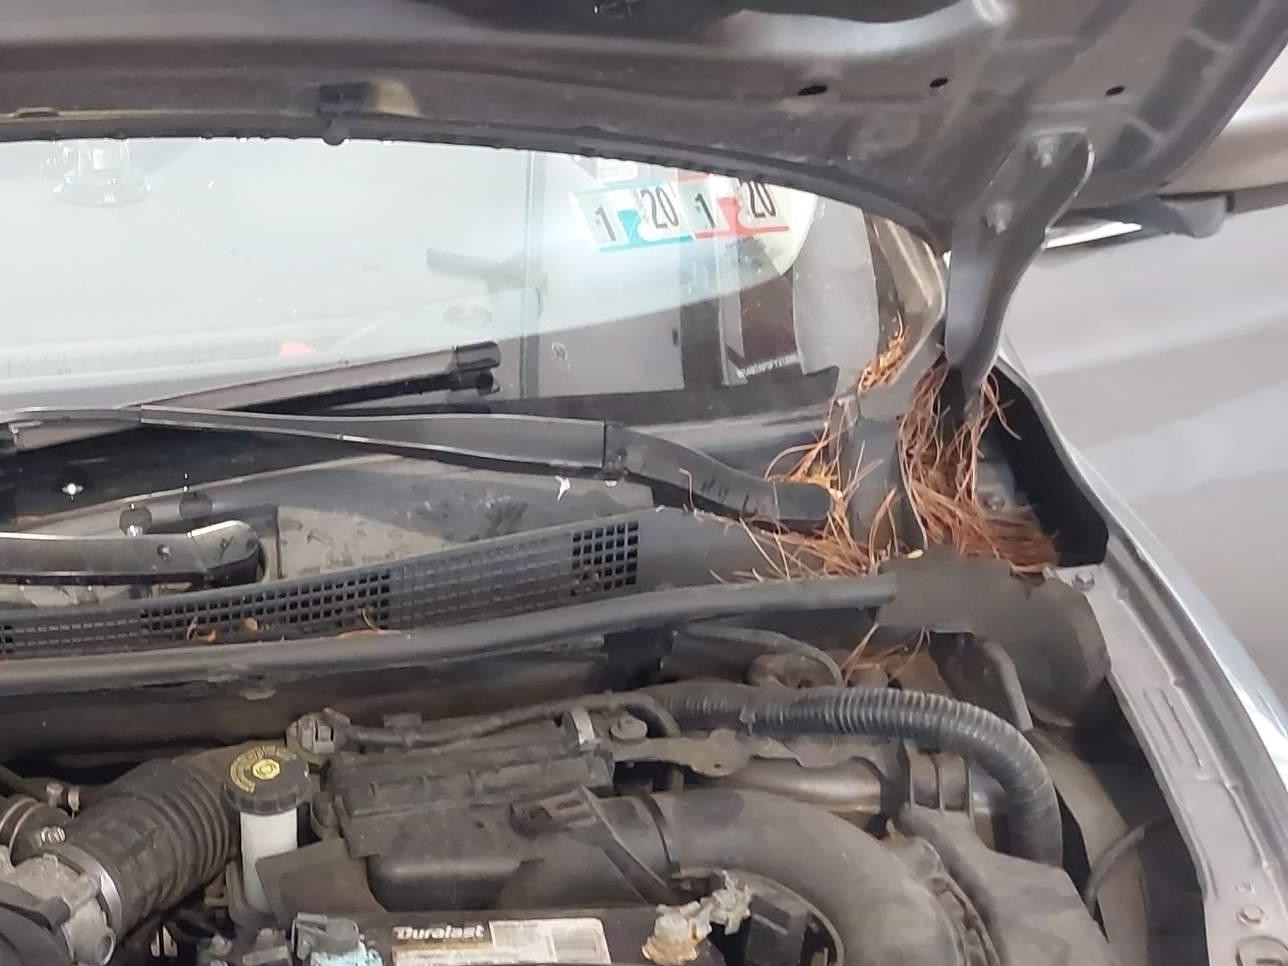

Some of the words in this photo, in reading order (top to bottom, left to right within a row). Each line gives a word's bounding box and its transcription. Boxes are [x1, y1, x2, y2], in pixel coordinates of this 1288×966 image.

[595, 206, 617, 242] 1
[640, 186, 679, 230] 20
[695, 192, 716, 229] 1
[747, 180, 777, 219] 20
[393, 924, 485, 940] Duralast
